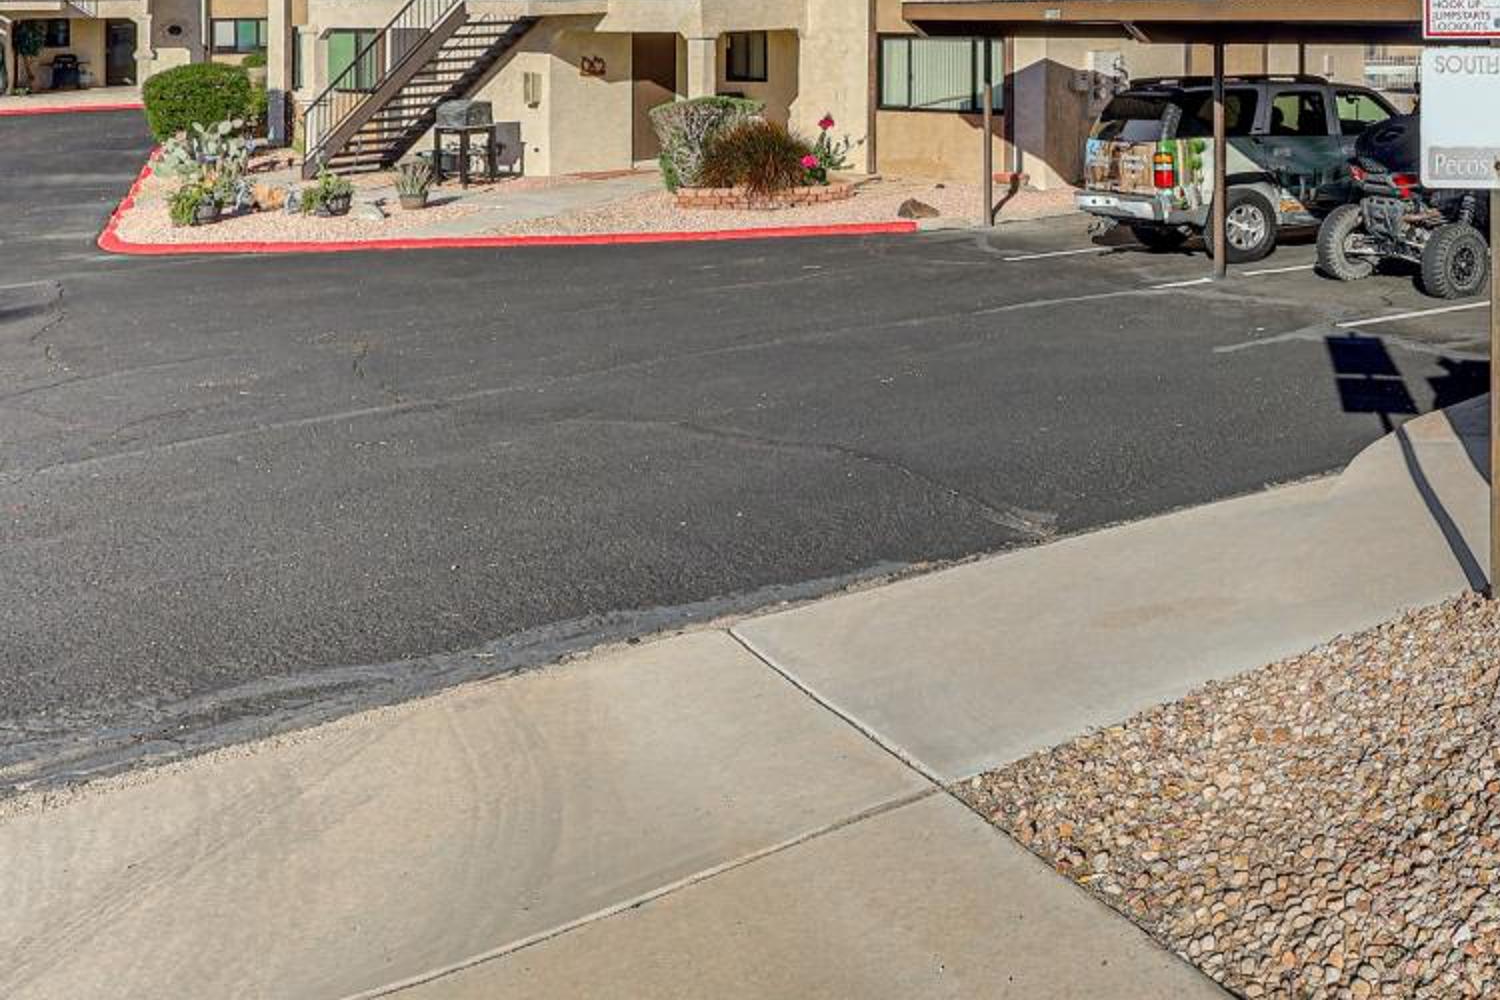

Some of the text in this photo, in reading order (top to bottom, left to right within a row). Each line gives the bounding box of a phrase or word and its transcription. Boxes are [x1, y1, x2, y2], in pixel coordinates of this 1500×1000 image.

[1432, 0, 1465, 9] HOOK
[1434, 55, 1499, 74] SOUTH
[1434, 153, 1489, 176] Pecos
